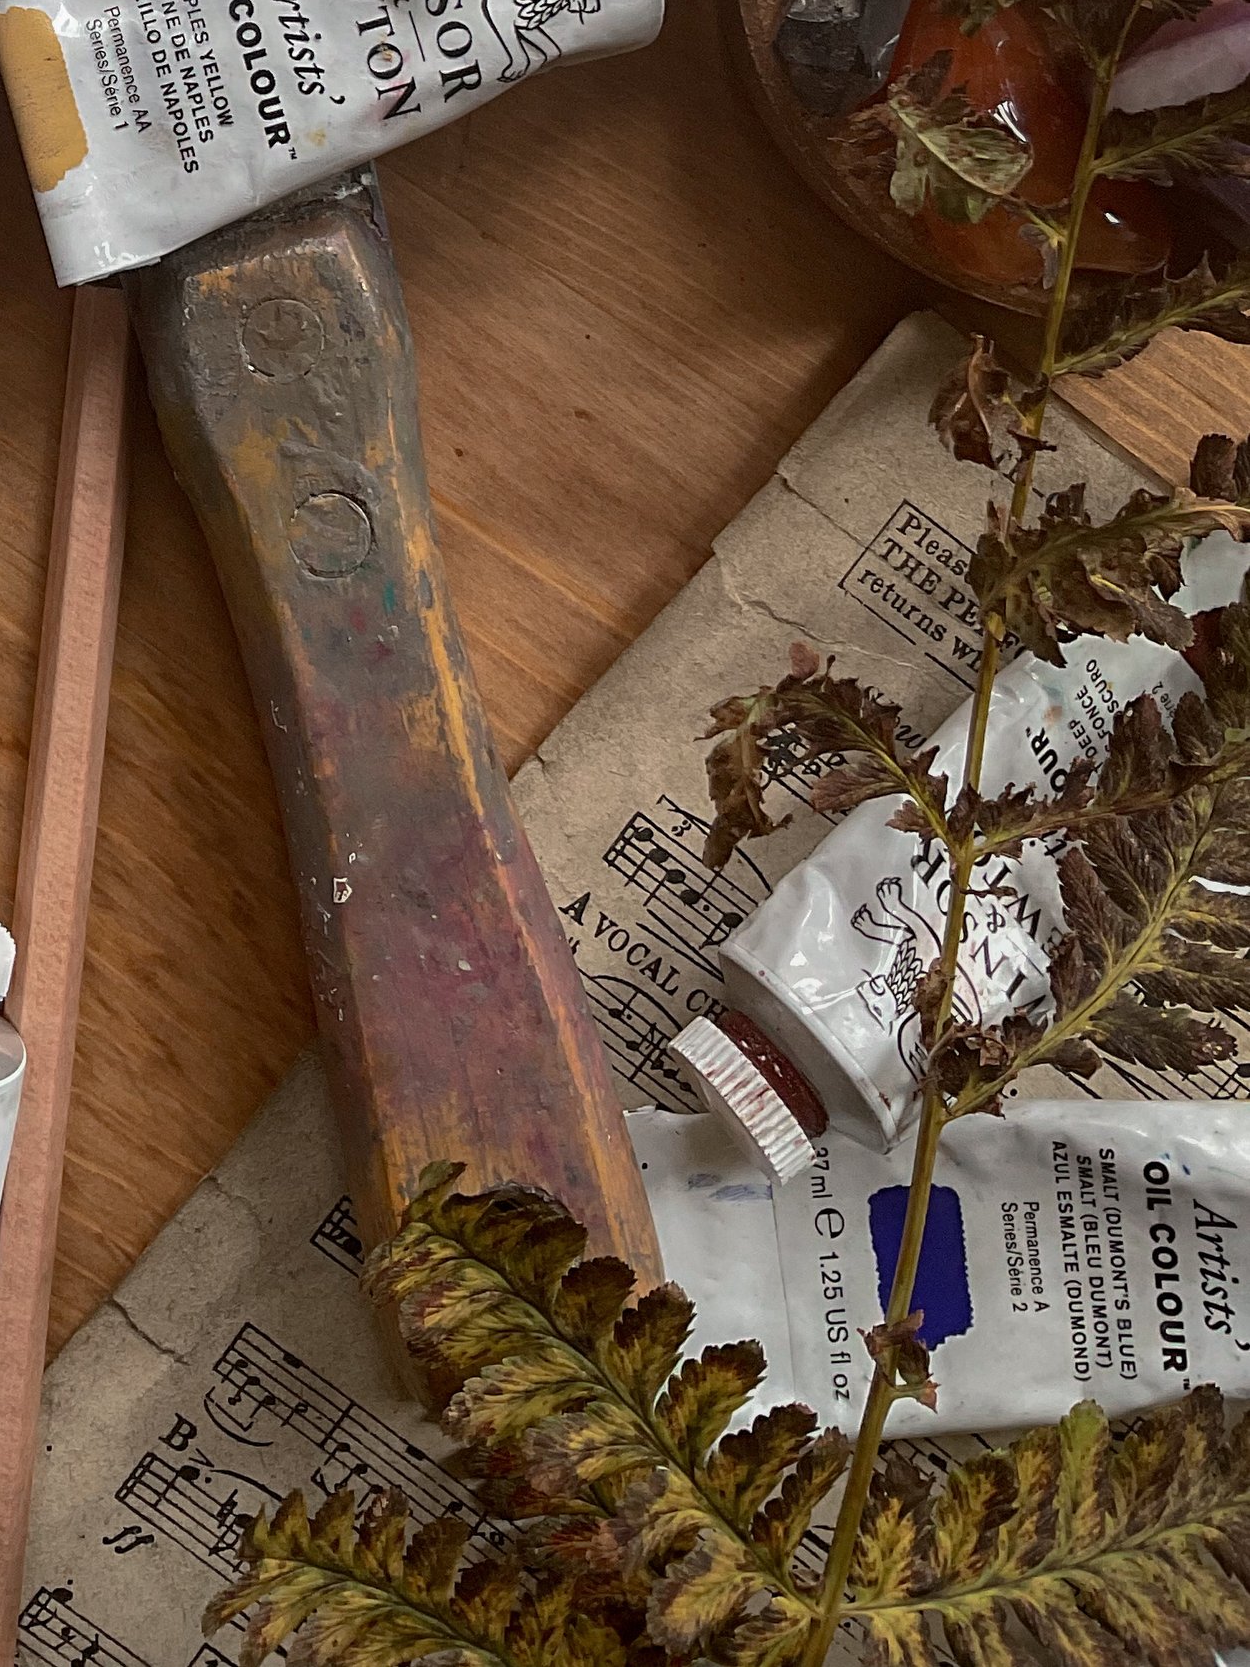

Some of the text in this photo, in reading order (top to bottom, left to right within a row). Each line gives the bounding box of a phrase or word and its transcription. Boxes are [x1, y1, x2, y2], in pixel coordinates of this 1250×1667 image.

[104, 5, 152, 133] Permanence AA
[172, 35, 190, 60] DE
[114, 118, 129, 131] 1
[153, 51, 170, 81] DE
[164, 87, 199, 175] NAPOLES
[180, 67, 214, 144] NAPLES
[200, 47, 235, 127] YELLOW
[879, 537, 942, 595] THE
[896, 511, 969, 576] Pleas
[857, 569, 948, 642] returns
[1068, 719, 1097, 759] DEEP
[558, 891, 730, 1024] A VOCAL CH
[1143, 1161, 1172, 1211] OIL
[1023, 1201, 1050, 1312] Permanence A
[1052, 1140, 1092, 1382] AZUL ESMALTE (DUMOND)
[1076, 1155, 1113, 1369] SMALT (BLEU DUMONT)
[1099, 1148, 1138, 1380] SMALT (DUMONT'S BLUE)
[819, 1251, 851, 1400] 1.25 US fl oz
[1013, 1302, 1028, 1313] 2
[158, 1412, 198, 1453] B
